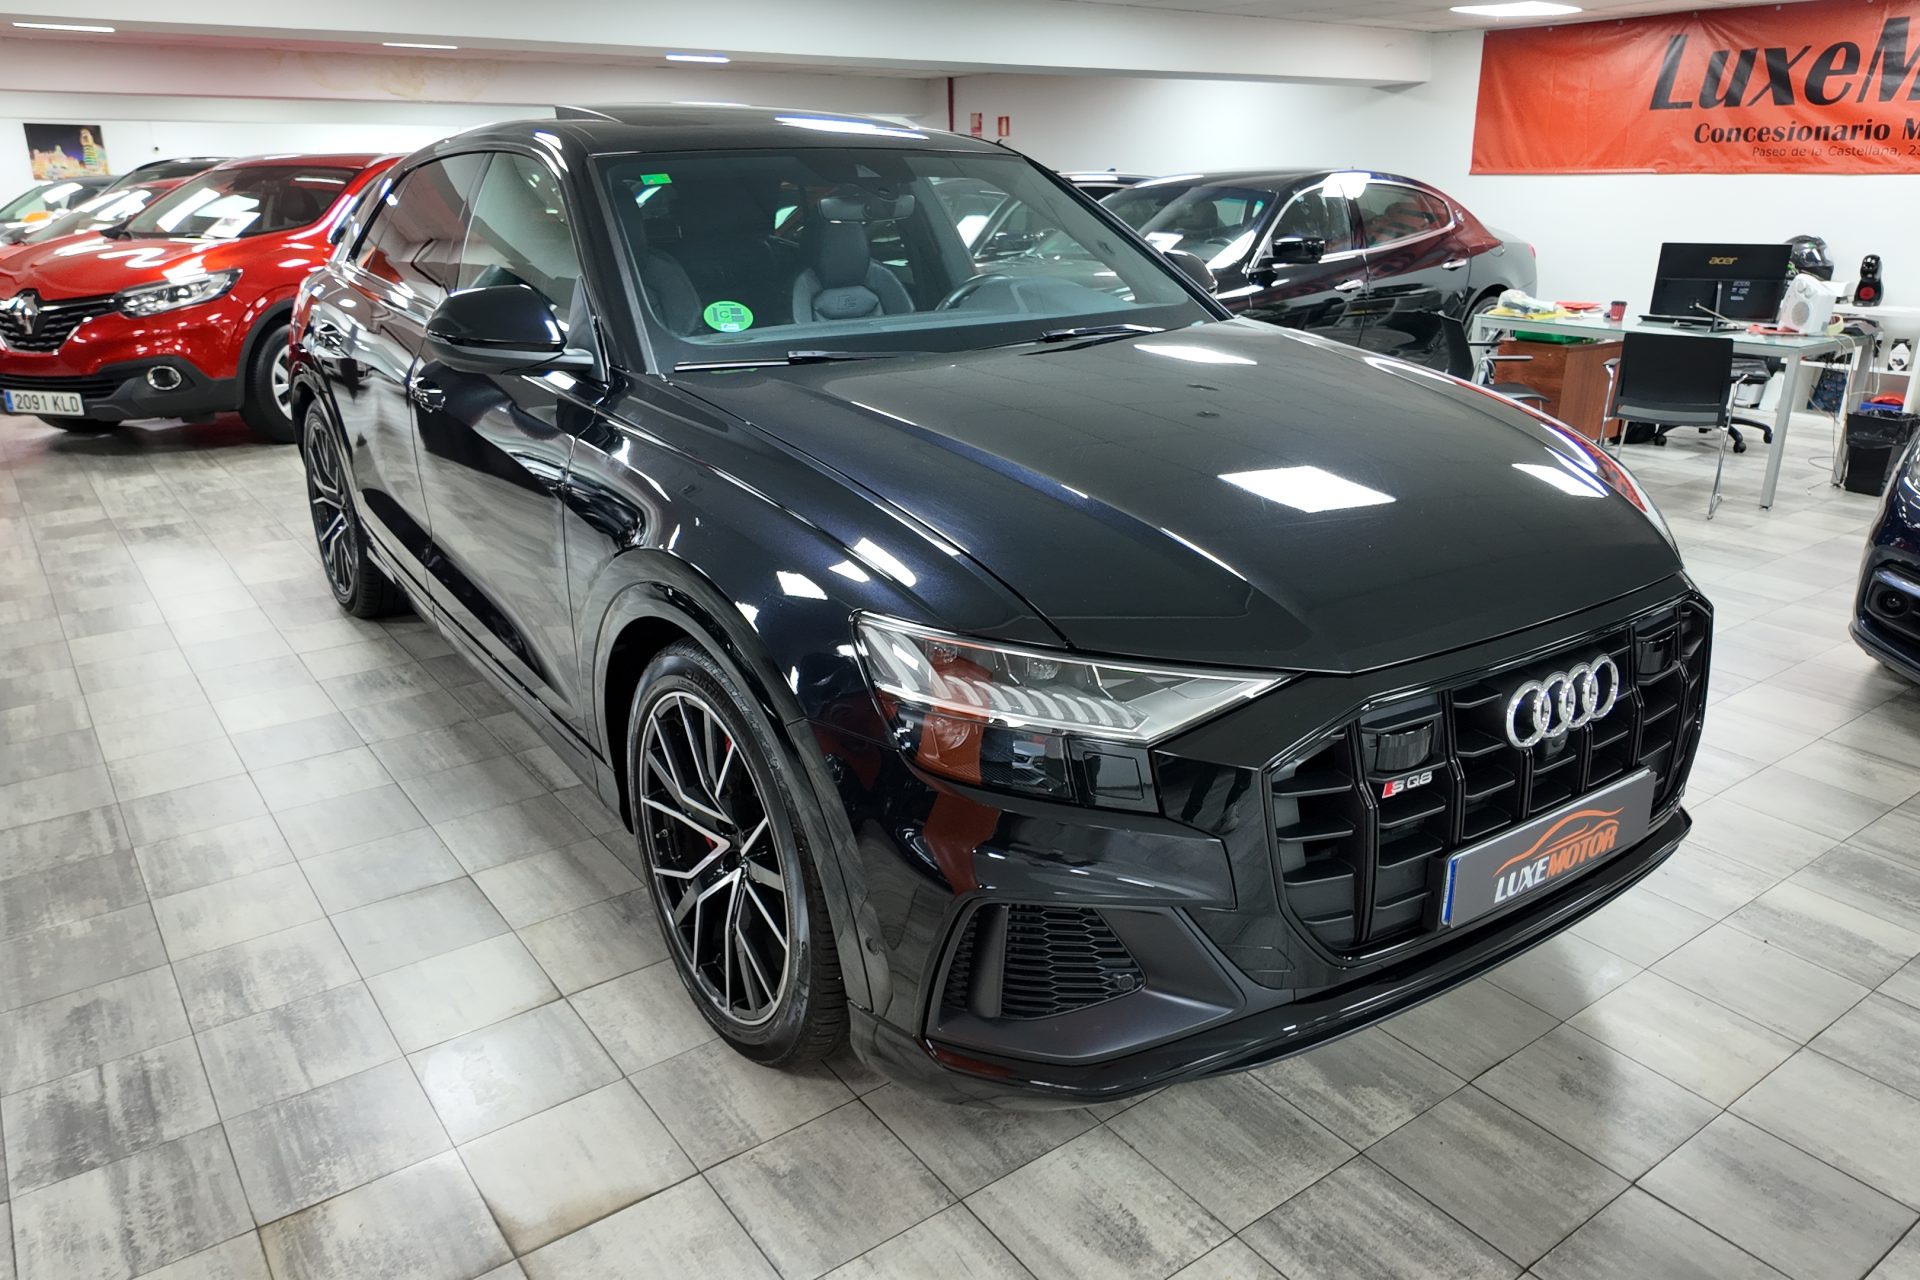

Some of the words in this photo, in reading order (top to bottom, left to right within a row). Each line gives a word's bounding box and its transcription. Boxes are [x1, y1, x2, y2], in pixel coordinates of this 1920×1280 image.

[1694, 118, 1891, 143] Concesionario
[1752, 147, 1787, 157] Paseo
[1791, 146, 1807, 157] de
[1708, 256, 1738, 265] acer
[15, 393, 48, 411] 2091
[52, 395, 80, 413] KLD
